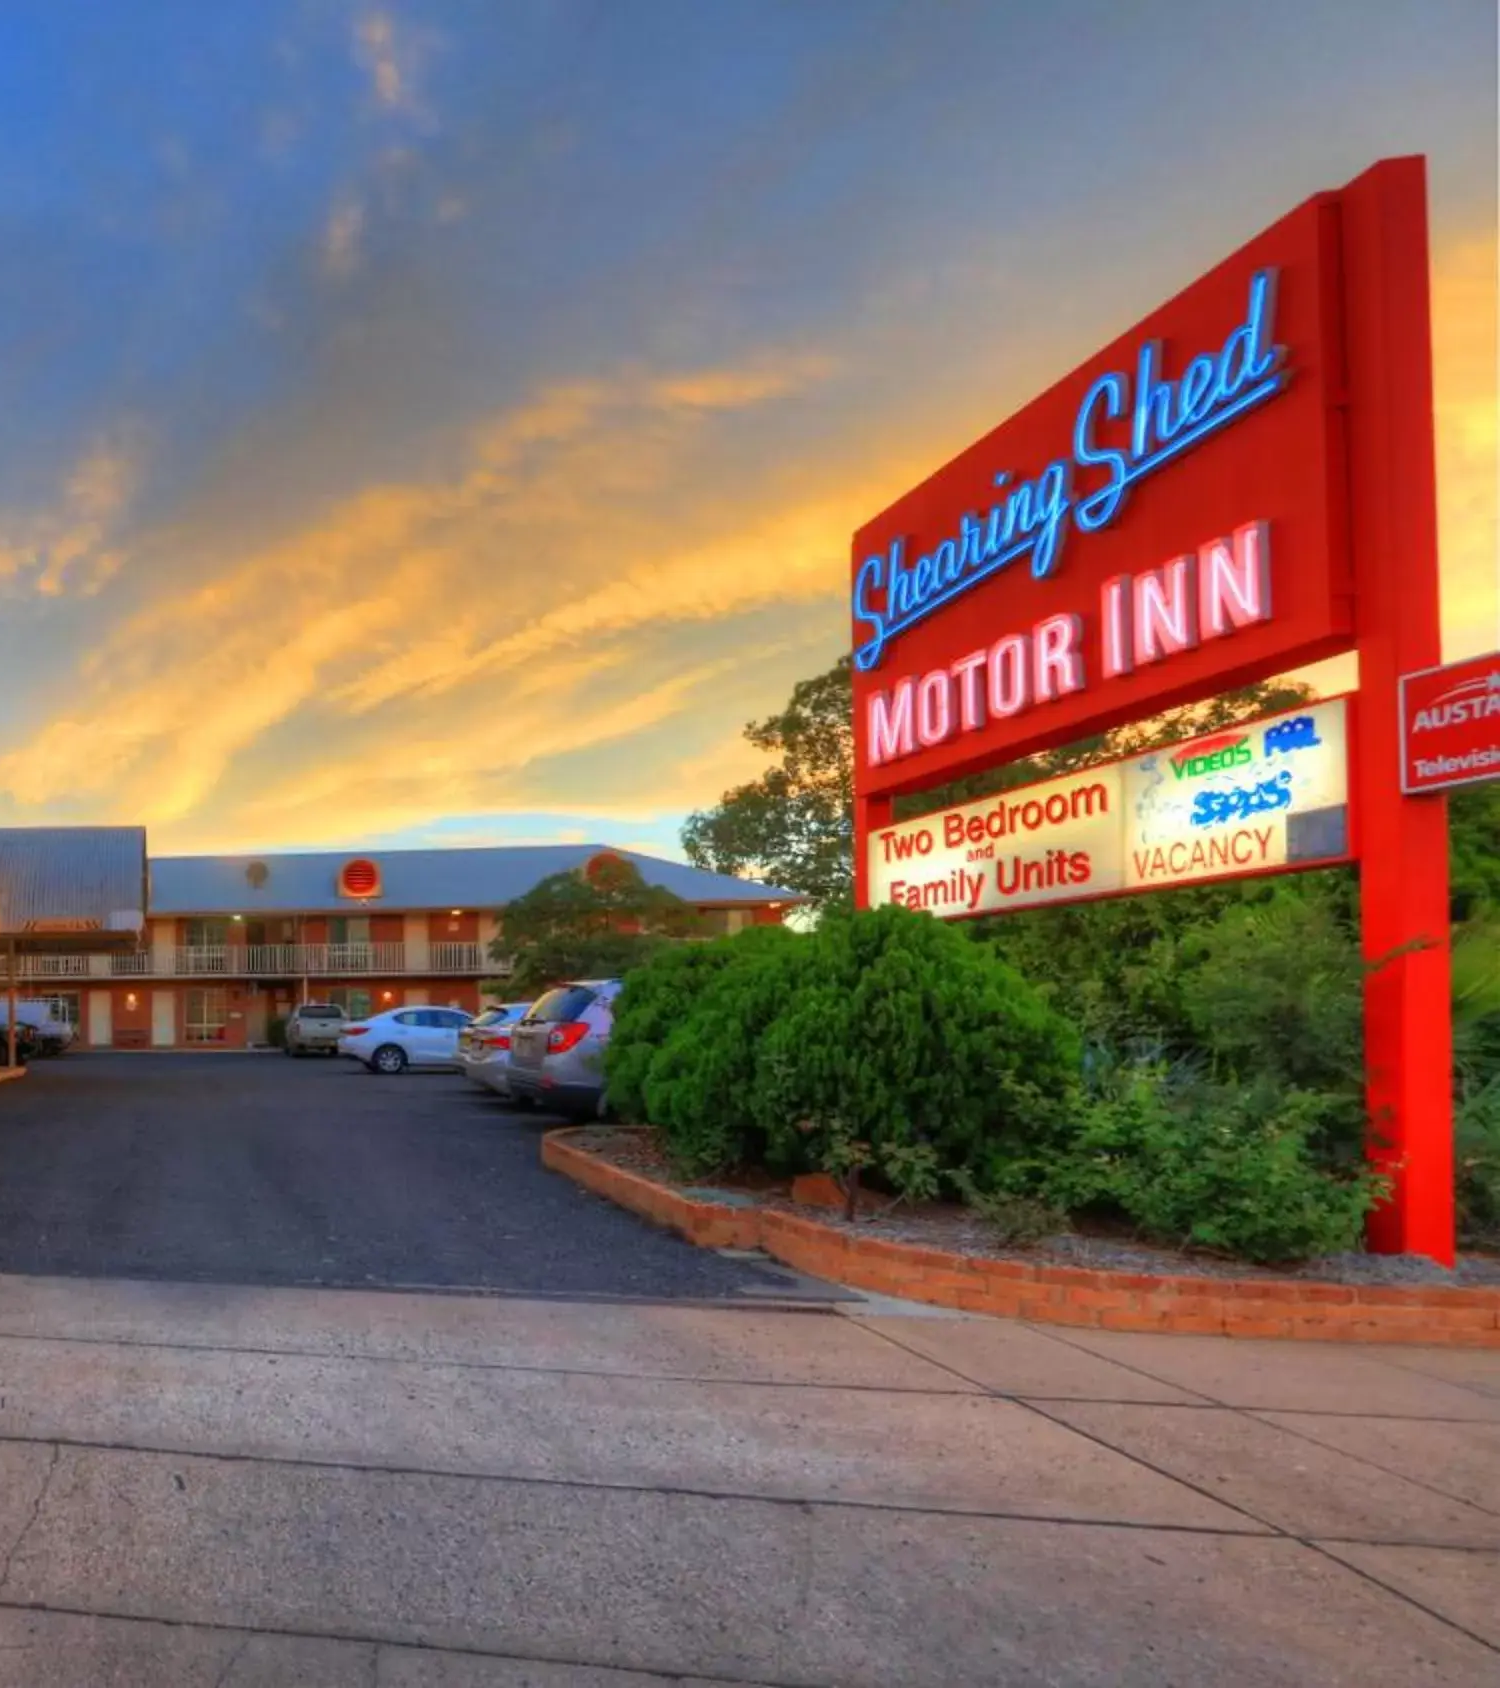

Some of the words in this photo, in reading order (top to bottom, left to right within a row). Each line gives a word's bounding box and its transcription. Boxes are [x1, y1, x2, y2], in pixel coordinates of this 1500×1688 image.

[851, 461, 1070, 670] Shearing
[1074, 269, 1282, 532] Shed
[866, 612, 1082, 769] MOTOR
[1102, 521, 1270, 679] INN
[1169, 736, 1252, 781] VIDEOS
[880, 828, 934, 864] Two
[943, 783, 1109, 849] Bedroom
[966, 842, 995, 863] and
[1133, 825, 1274, 880] VACANCY
[890, 868, 984, 910] Family
[997, 849, 1092, 896] Units
